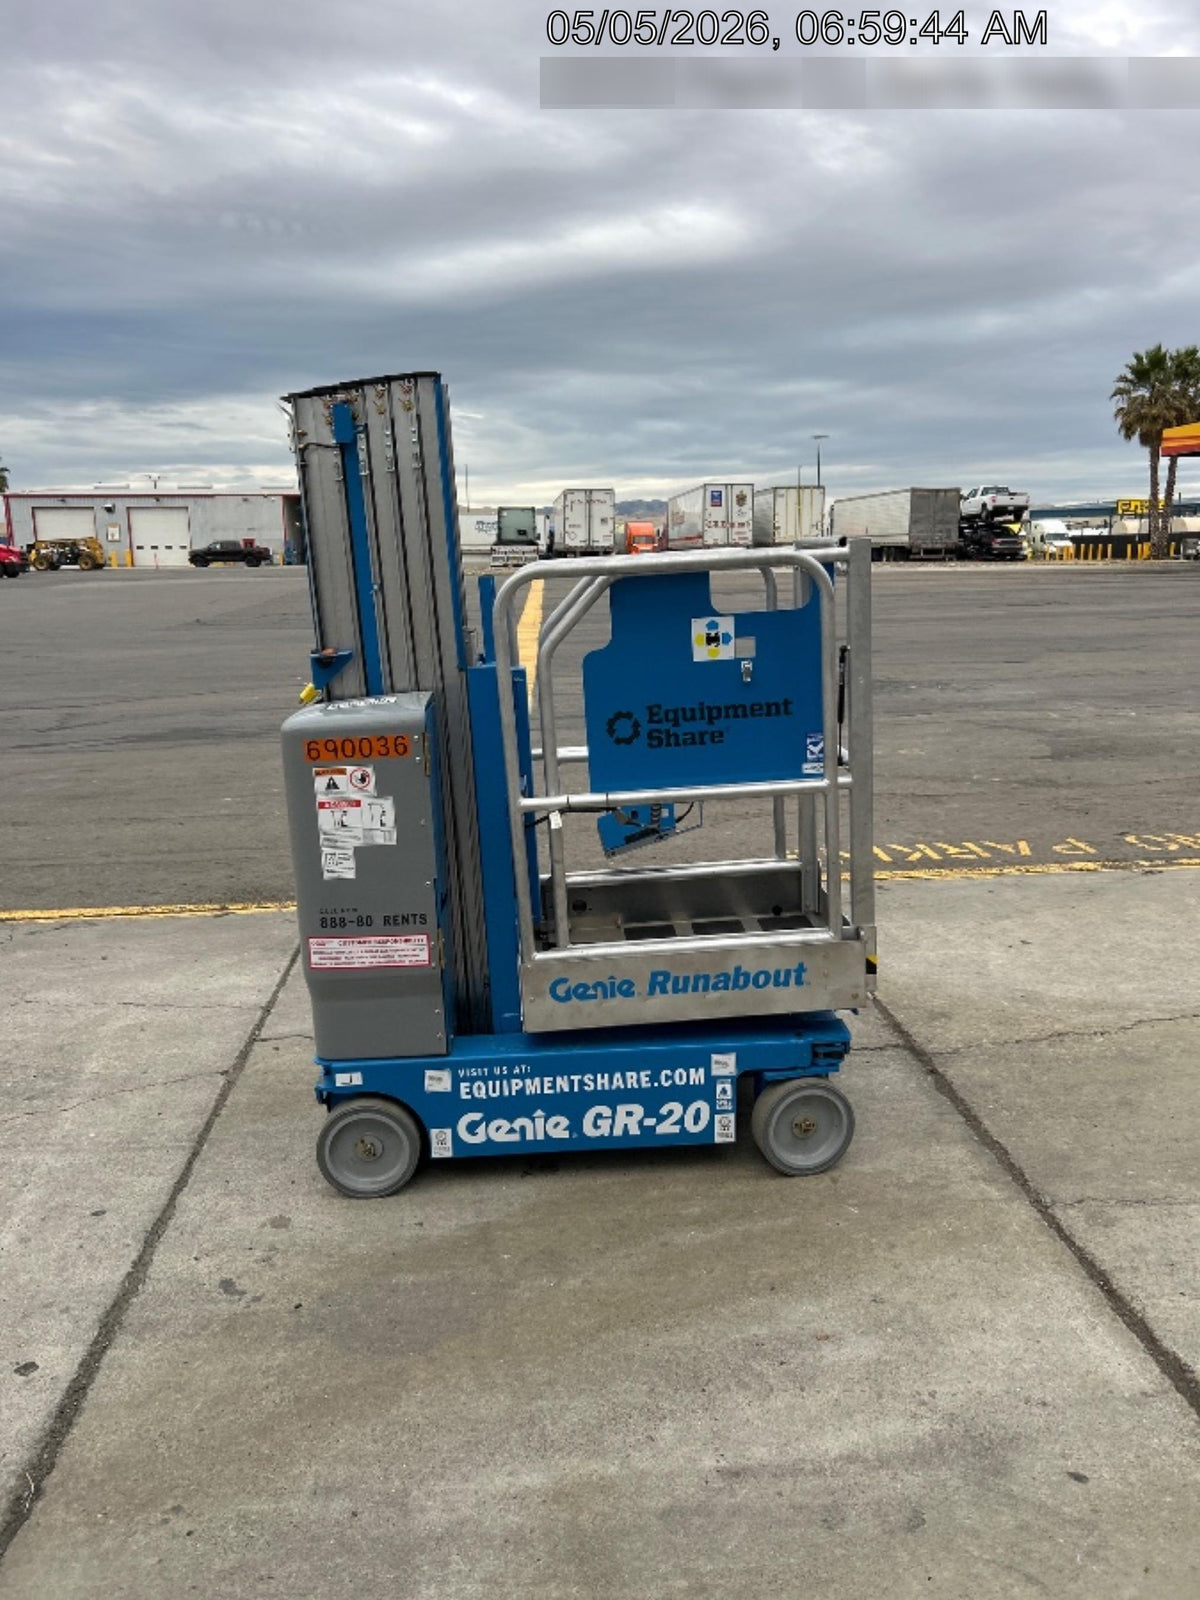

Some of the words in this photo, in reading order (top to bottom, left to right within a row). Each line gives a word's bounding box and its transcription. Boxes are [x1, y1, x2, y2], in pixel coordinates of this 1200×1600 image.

[646, 698, 793, 727] Equipment
[306, 735, 408, 760] 690036
[646, 727, 724, 749] Share
[320, 914, 373, 929] 888-80
[383, 913, 428, 927] RENTS
[550, 976, 636, 1003] Genie
[646, 961, 808, 996] Runabout
[458, 1067, 488, 1078] VISIT
[494, 1065, 508, 1075] US
[513, 1064, 531, 1075] AT:
[459, 1067, 705, 1100] EQUIPMENTSHARE.COM
[457, 1108, 570, 1144] Genie
[582, 1100, 711, 1138] GR-20
